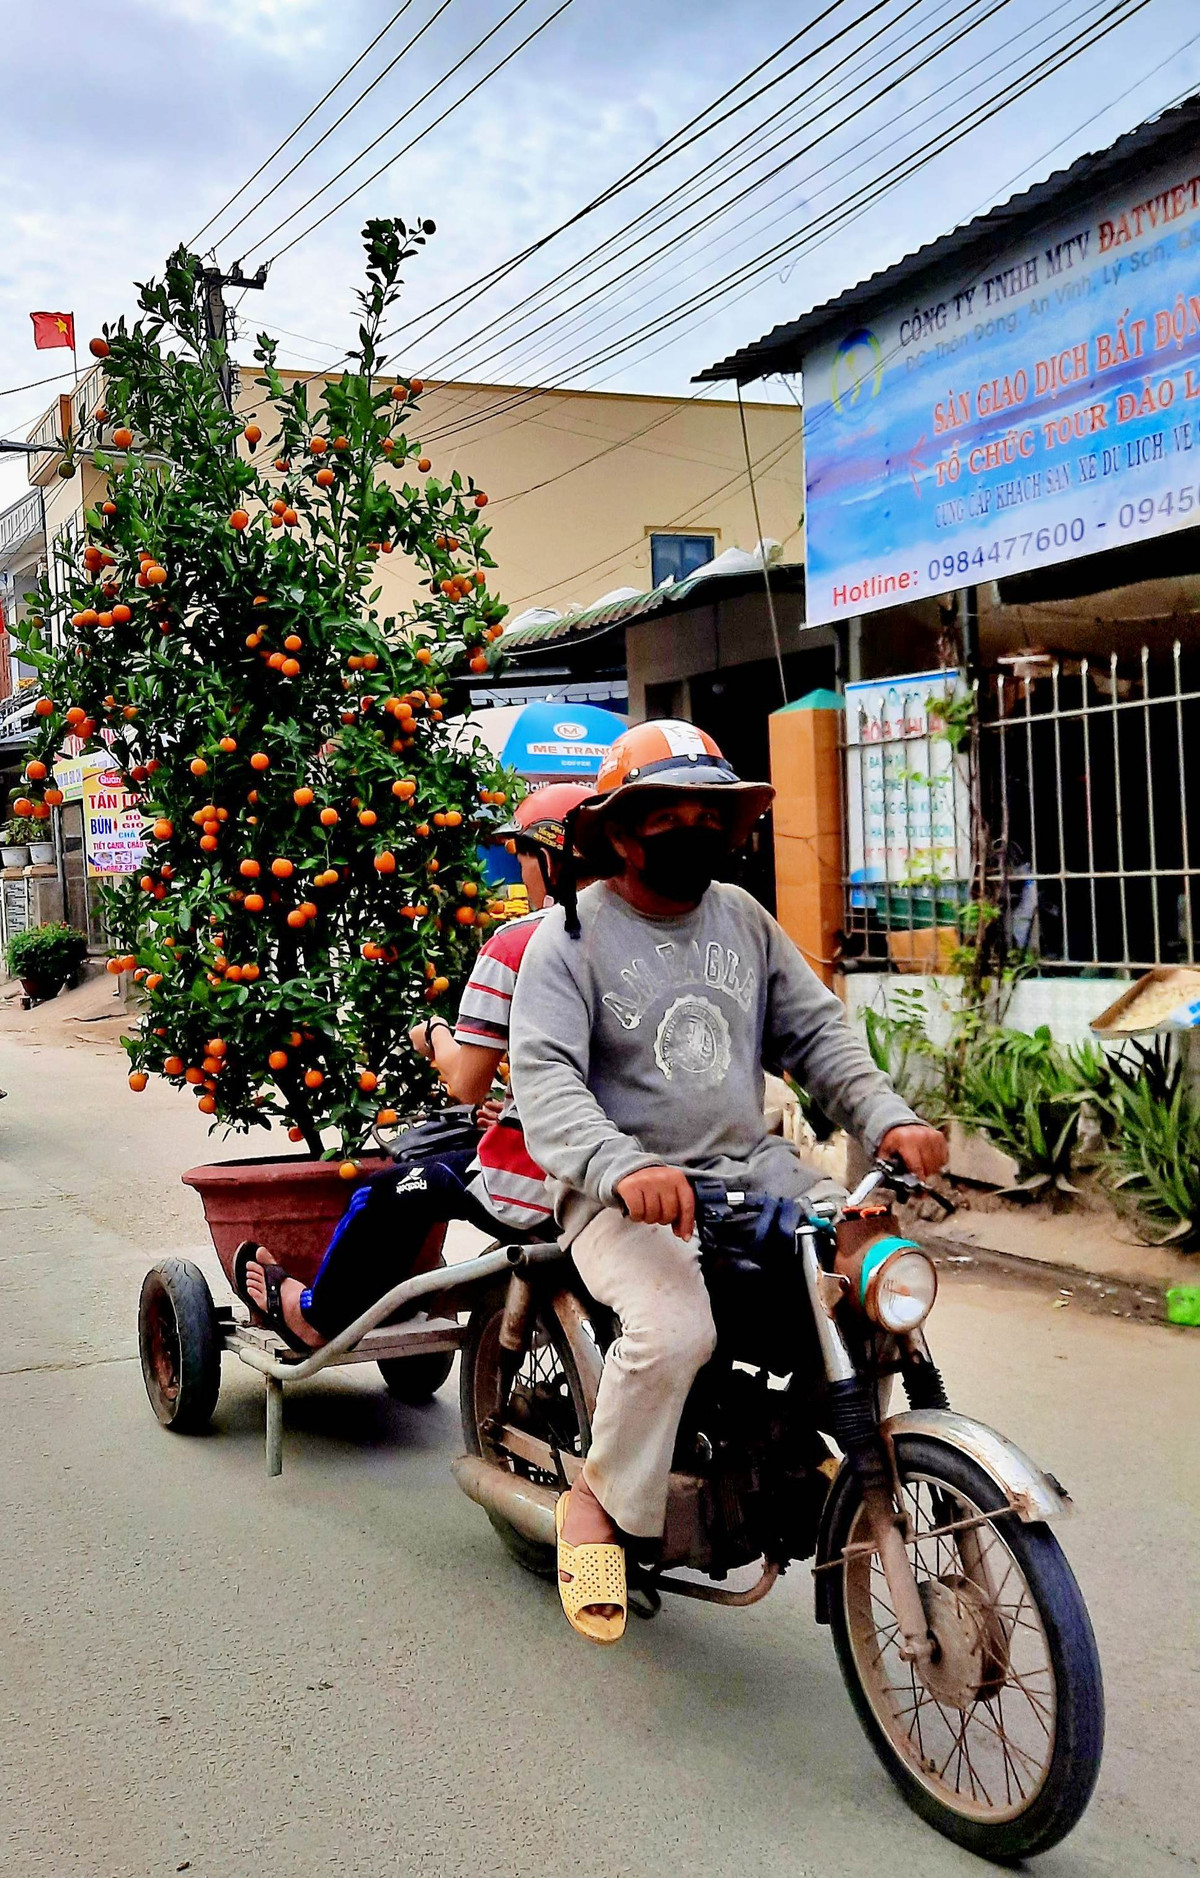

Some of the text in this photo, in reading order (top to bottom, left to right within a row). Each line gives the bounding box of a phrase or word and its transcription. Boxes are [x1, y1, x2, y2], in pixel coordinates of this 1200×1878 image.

[900, 300, 948, 347] CÔNG
[953, 286, 976, 321] TY
[982, 257, 1038, 308] TNHH
[1045, 230, 1091, 279] MTV
[1103, 259, 1121, 285] Lý
[977, 368, 1028, 417] GIAO
[1035, 343, 1089, 400] DỊCH
[1097, 308, 1146, 372] BẤT
[936, 440, 961, 487] TỔ
[969, 429, 1034, 475] CHỨC
[1043, 403, 1108, 450] TOUR
[1117, 377, 1175, 424] ĐẢO
[936, 499, 964, 528] CUNG
[996, 470, 1041, 510] KHÁCH
[1078, 453, 1097, 484] XE
[832, 566, 919, 607] Hotline:
[928, 517, 1085, 581] 0984477600
[533, 745, 558, 754] ME
[561, 759, 591, 767] COFFEE
[88, 789, 118, 809] TẤN
[90, 814, 112, 835] BÚN
